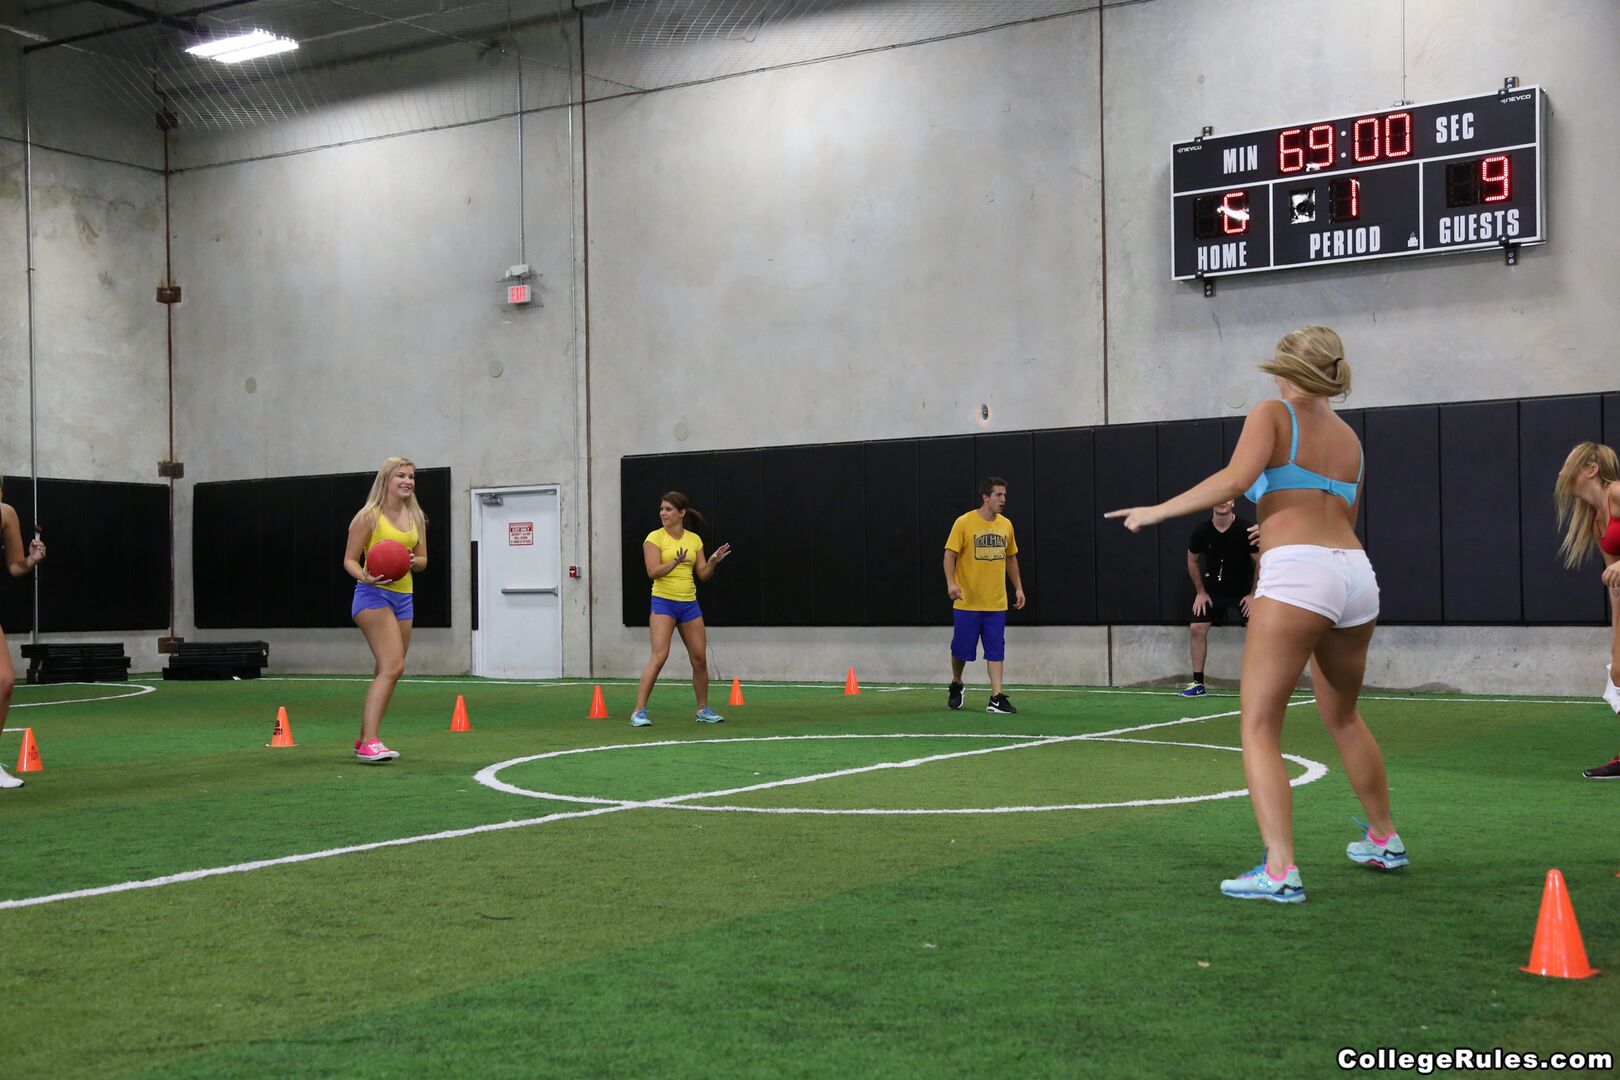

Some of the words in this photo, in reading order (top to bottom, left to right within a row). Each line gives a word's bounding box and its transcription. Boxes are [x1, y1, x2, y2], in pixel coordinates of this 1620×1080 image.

[1279, 112, 1411, 173] 69:00
[1435, 112, 1475, 144] SEC
[1223, 144, 1258, 175] MIN
[1481, 155, 1509, 202] 9
[1309, 225, 1381, 259] PERIOD
[1439, 208, 1520, 244] GUESTS
[1197, 241, 1247, 271] HOME
